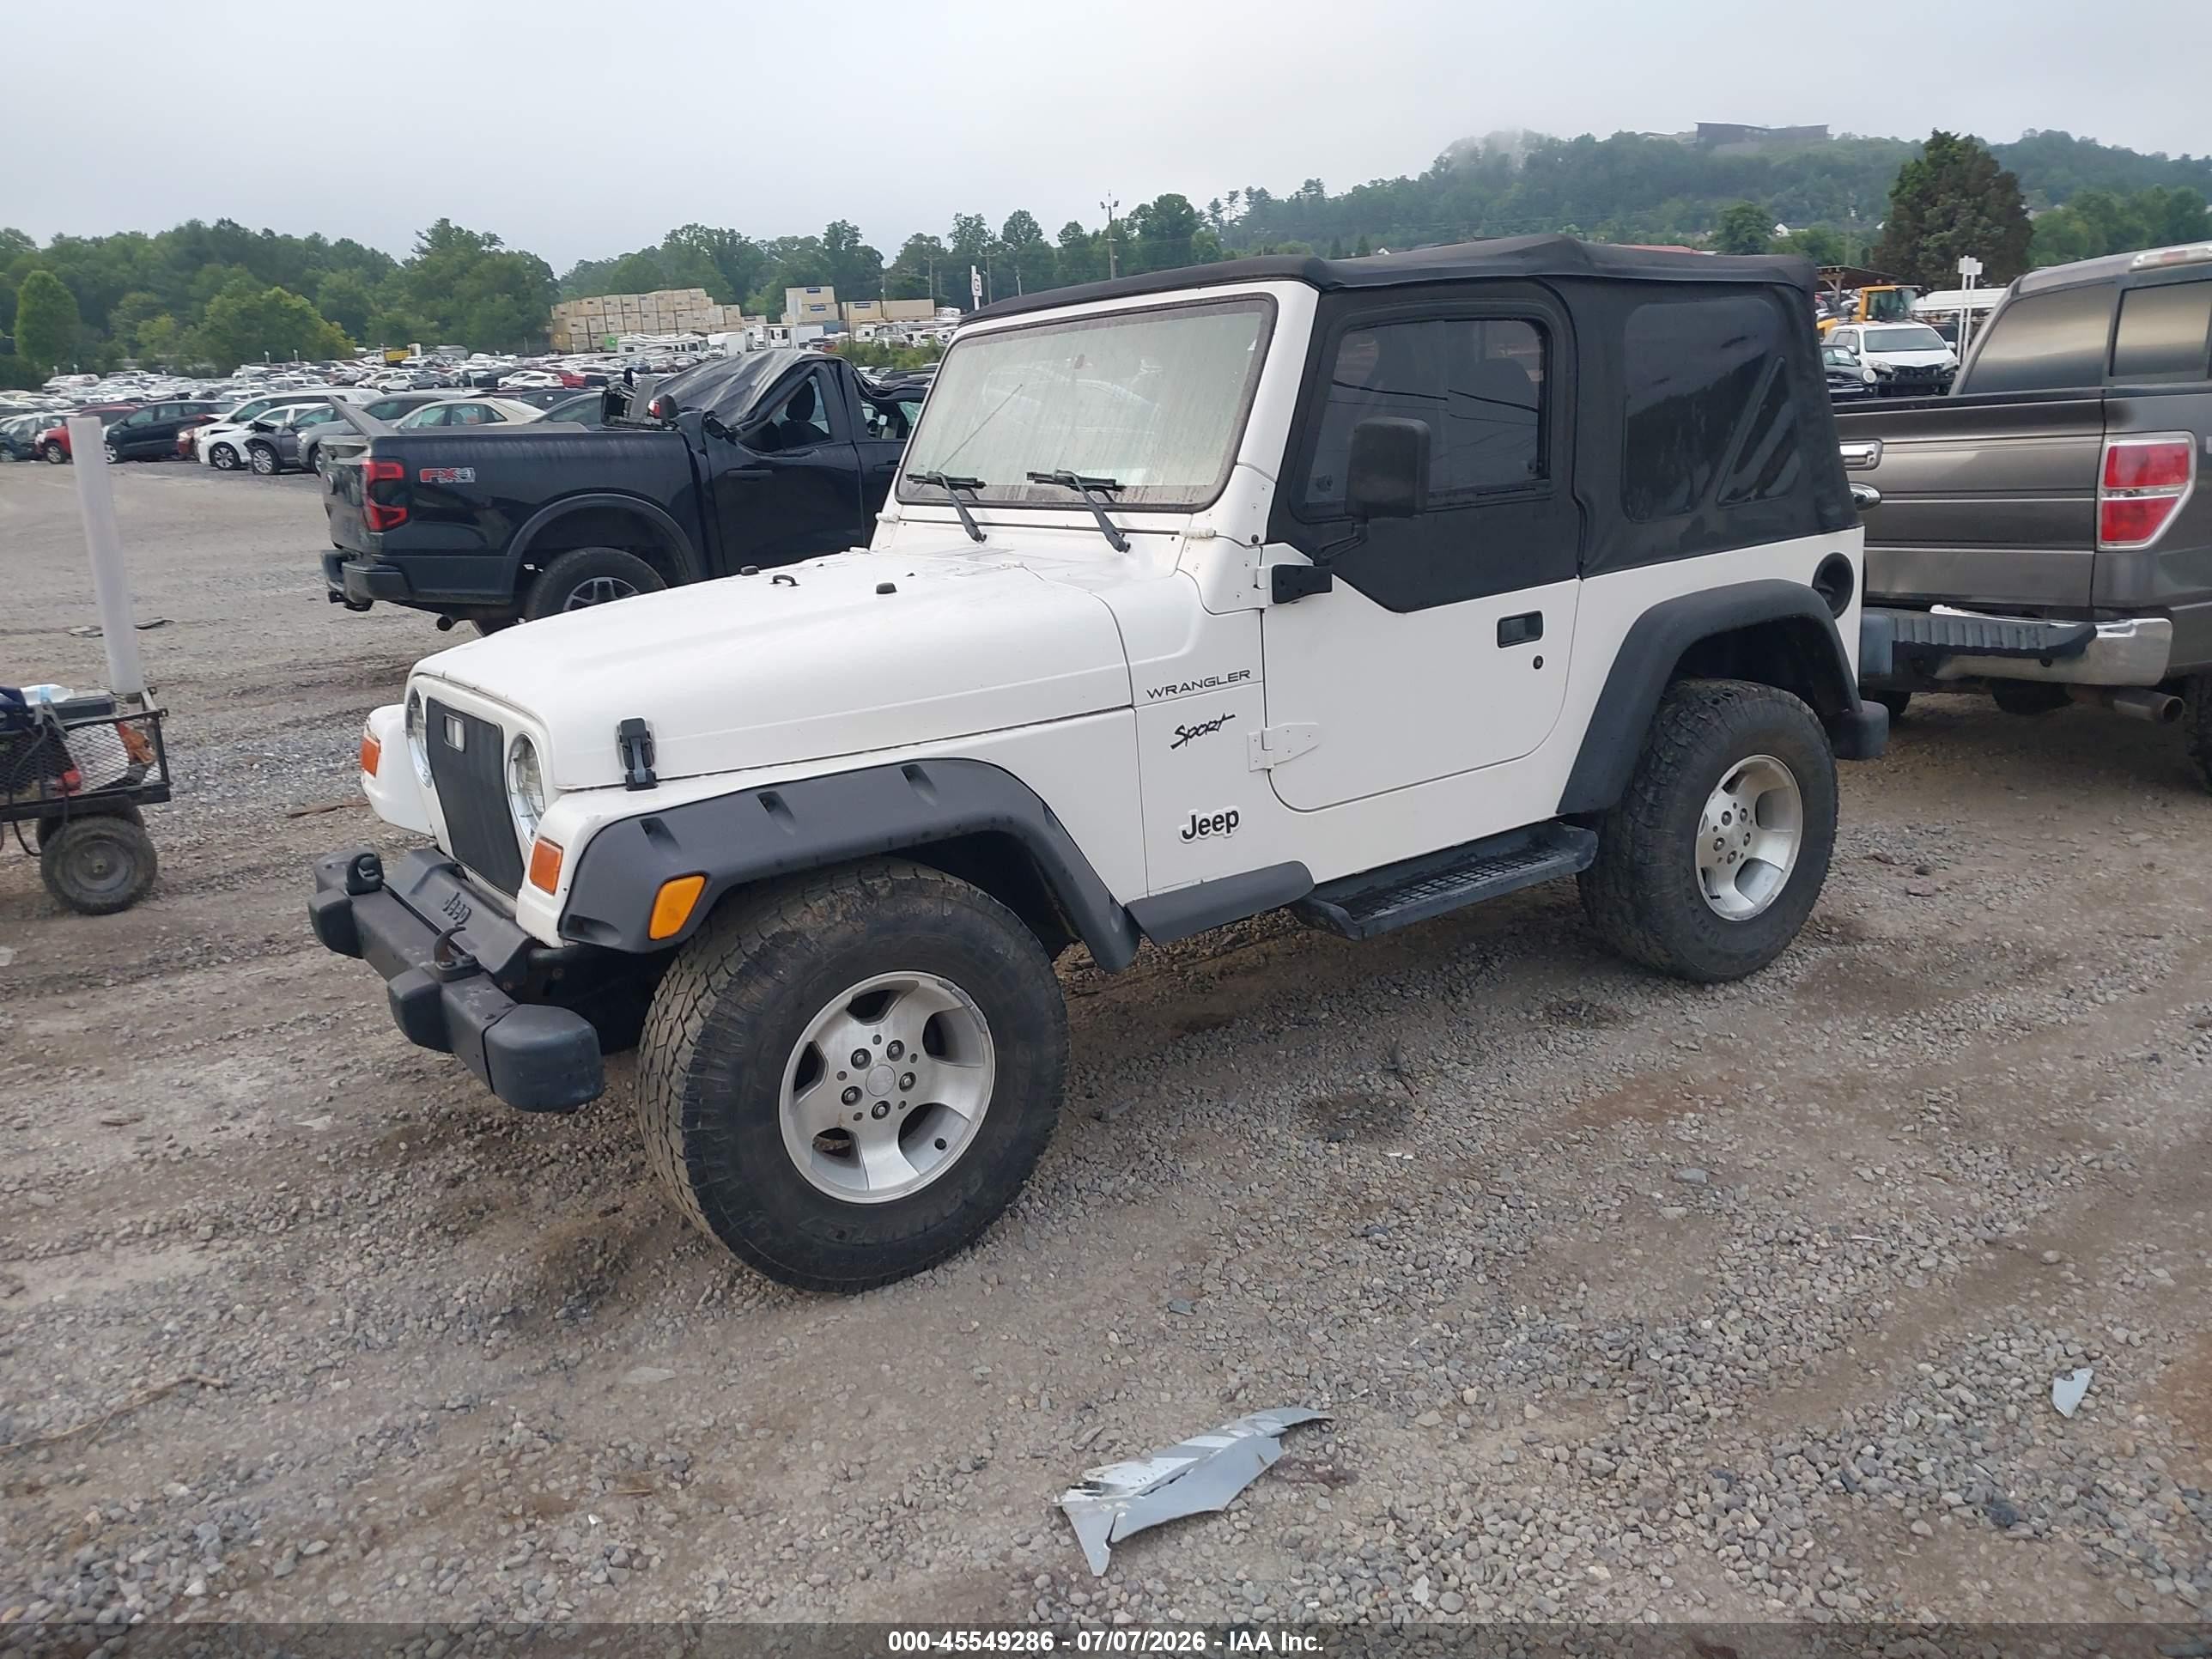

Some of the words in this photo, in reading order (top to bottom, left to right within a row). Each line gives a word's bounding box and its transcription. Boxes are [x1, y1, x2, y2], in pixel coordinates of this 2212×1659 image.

[419, 467, 476, 483] FX4
[1146, 669, 1251, 699] WRANGLER
[1181, 810, 1239, 840] Jeep
[442, 892, 472, 927] Jeep
